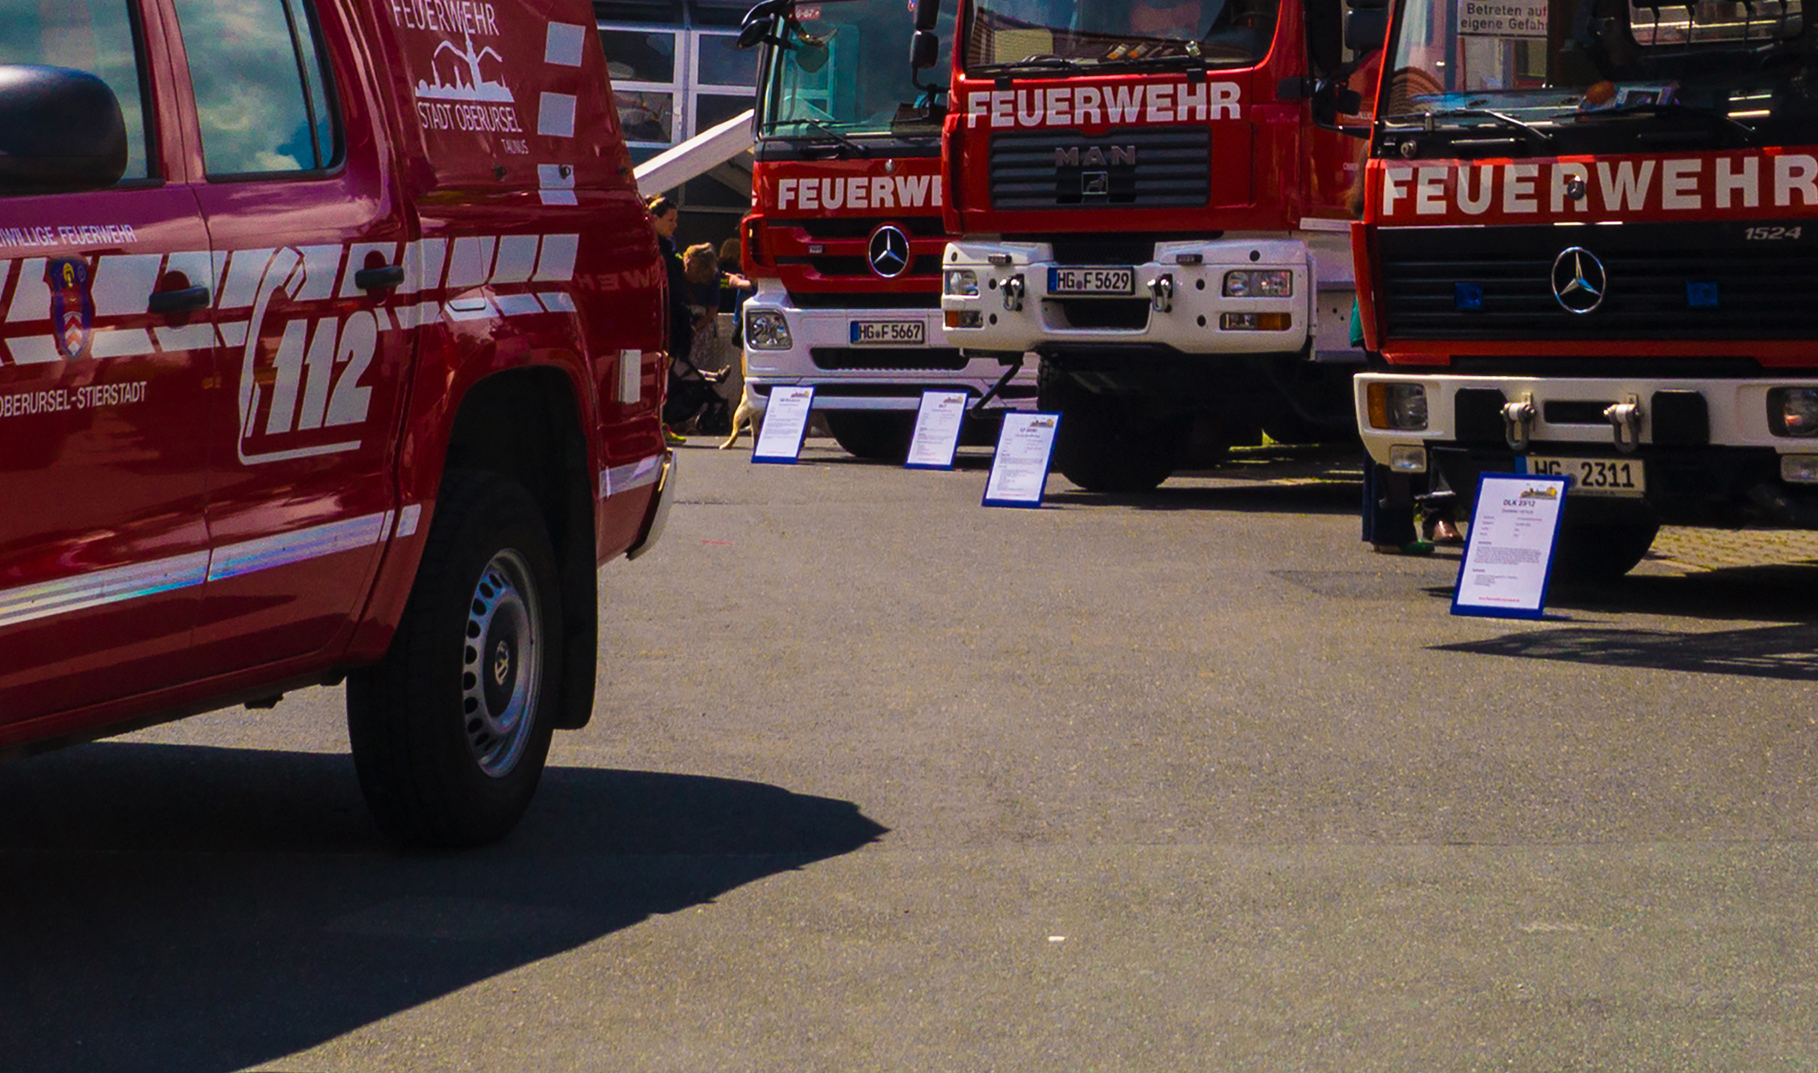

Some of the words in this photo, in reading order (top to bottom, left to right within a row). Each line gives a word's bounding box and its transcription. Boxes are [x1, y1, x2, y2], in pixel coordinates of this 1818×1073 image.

[1466, 3, 1522, 17] Betreten
[1460, 18, 1503, 32] eigene
[967, 80, 1242, 129] FEUERWEHR
[417, 101, 456, 130] STADT
[455, 104, 523, 133] OBERURSEL
[1054, 144, 1137, 167] MAN
[57, 223, 138, 245] FEUERWEHR
[1744, 226, 1802, 241] 1524
[1057, 270, 1075, 289] HG
[1083, 271, 1092, 289] F
[1094, 271, 1129, 290] 5629
[858, 324, 875, 339] HG
[891, 324, 921, 339] 5667
[265, 310, 378, 435] 112
[1581, 461, 1635, 488] 2311
